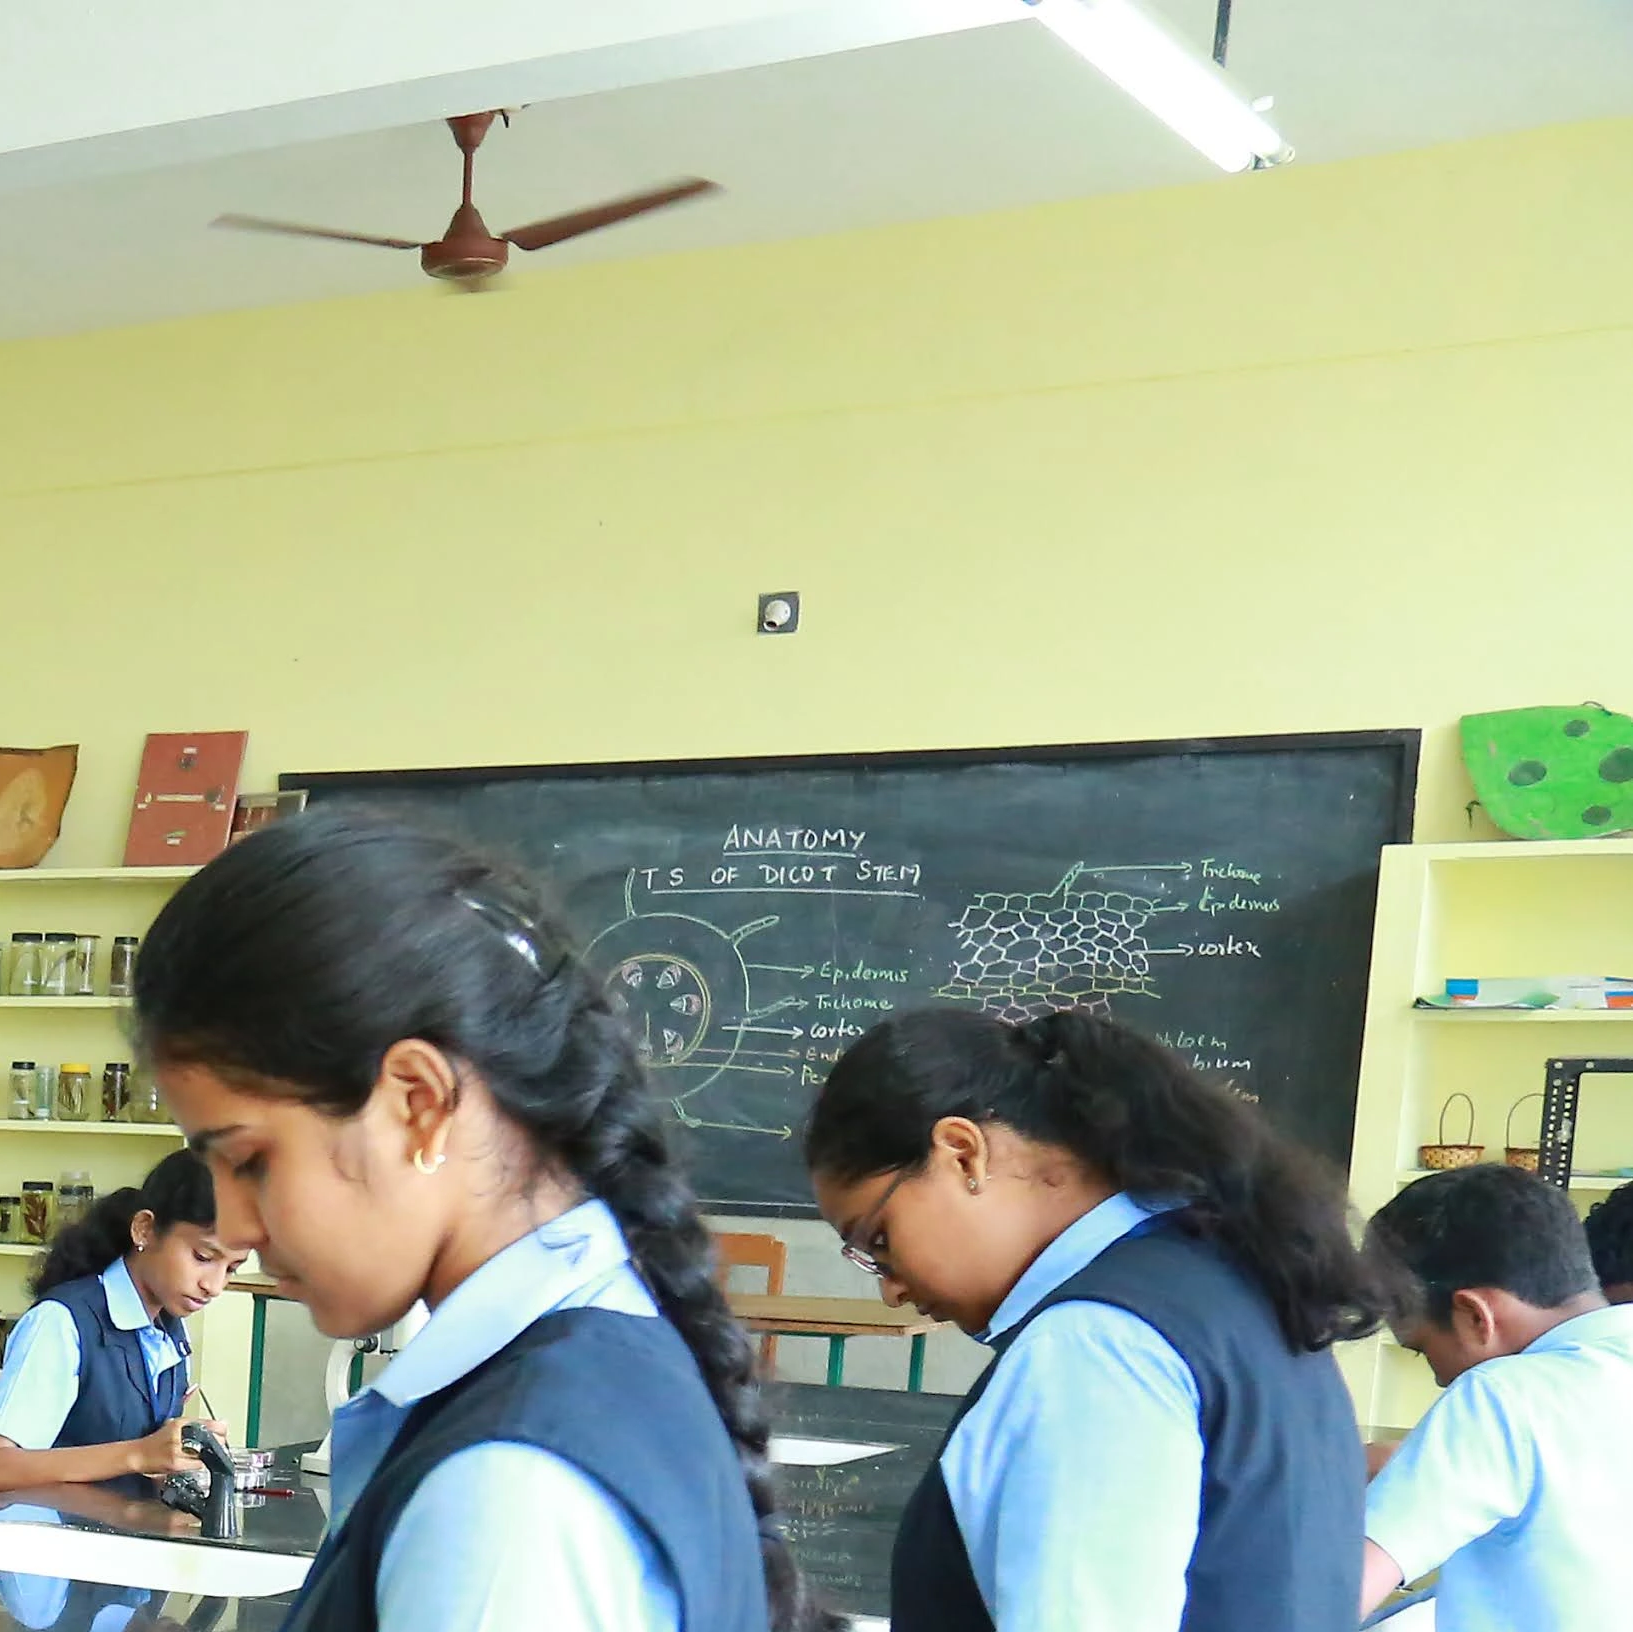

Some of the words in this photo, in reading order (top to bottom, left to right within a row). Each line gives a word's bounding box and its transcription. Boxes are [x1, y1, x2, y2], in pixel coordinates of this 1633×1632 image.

[723, 823, 866, 850] ANATOMY
[710, 866, 740, 885] OF
[758, 863, 838, 885] DICOT
[856, 859, 921, 887] STEM
[819, 959, 910, 985] Epidermis
[805, 1046, 846, 1062] End
